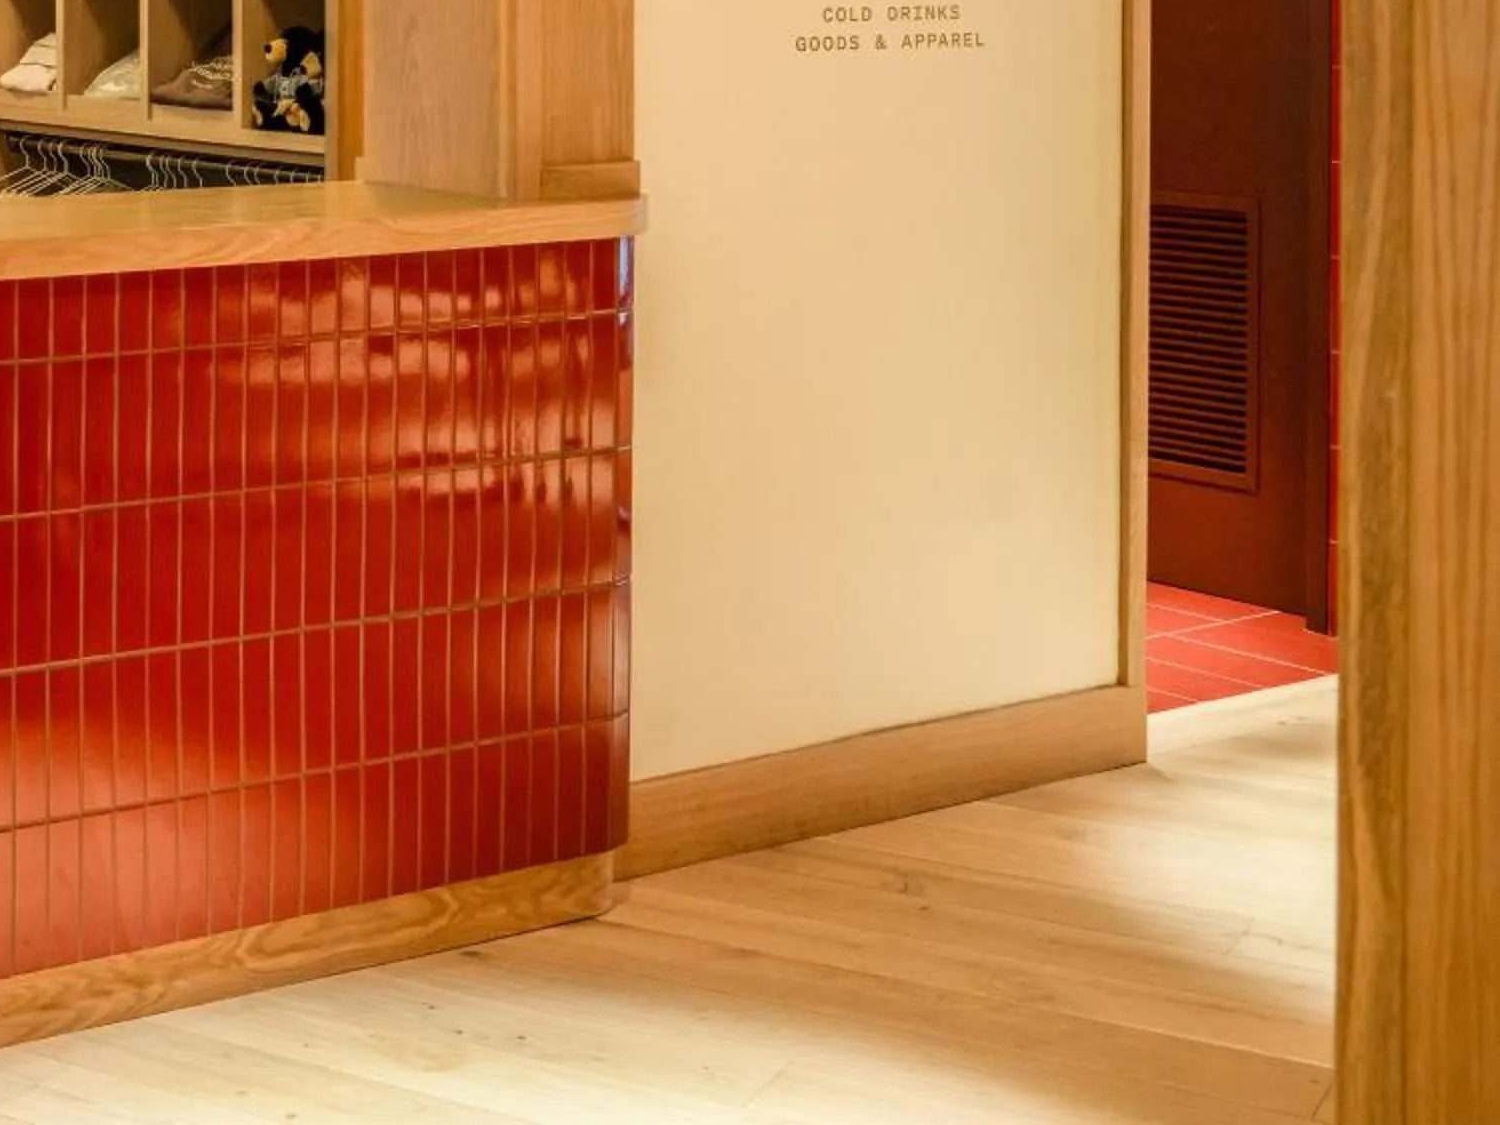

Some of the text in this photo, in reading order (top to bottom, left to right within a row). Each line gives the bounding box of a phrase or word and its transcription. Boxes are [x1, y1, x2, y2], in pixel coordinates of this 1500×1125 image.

[822, 4, 960, 23] COLD DRINKS
[795, 32, 985, 52] GOODS & APPAREL
